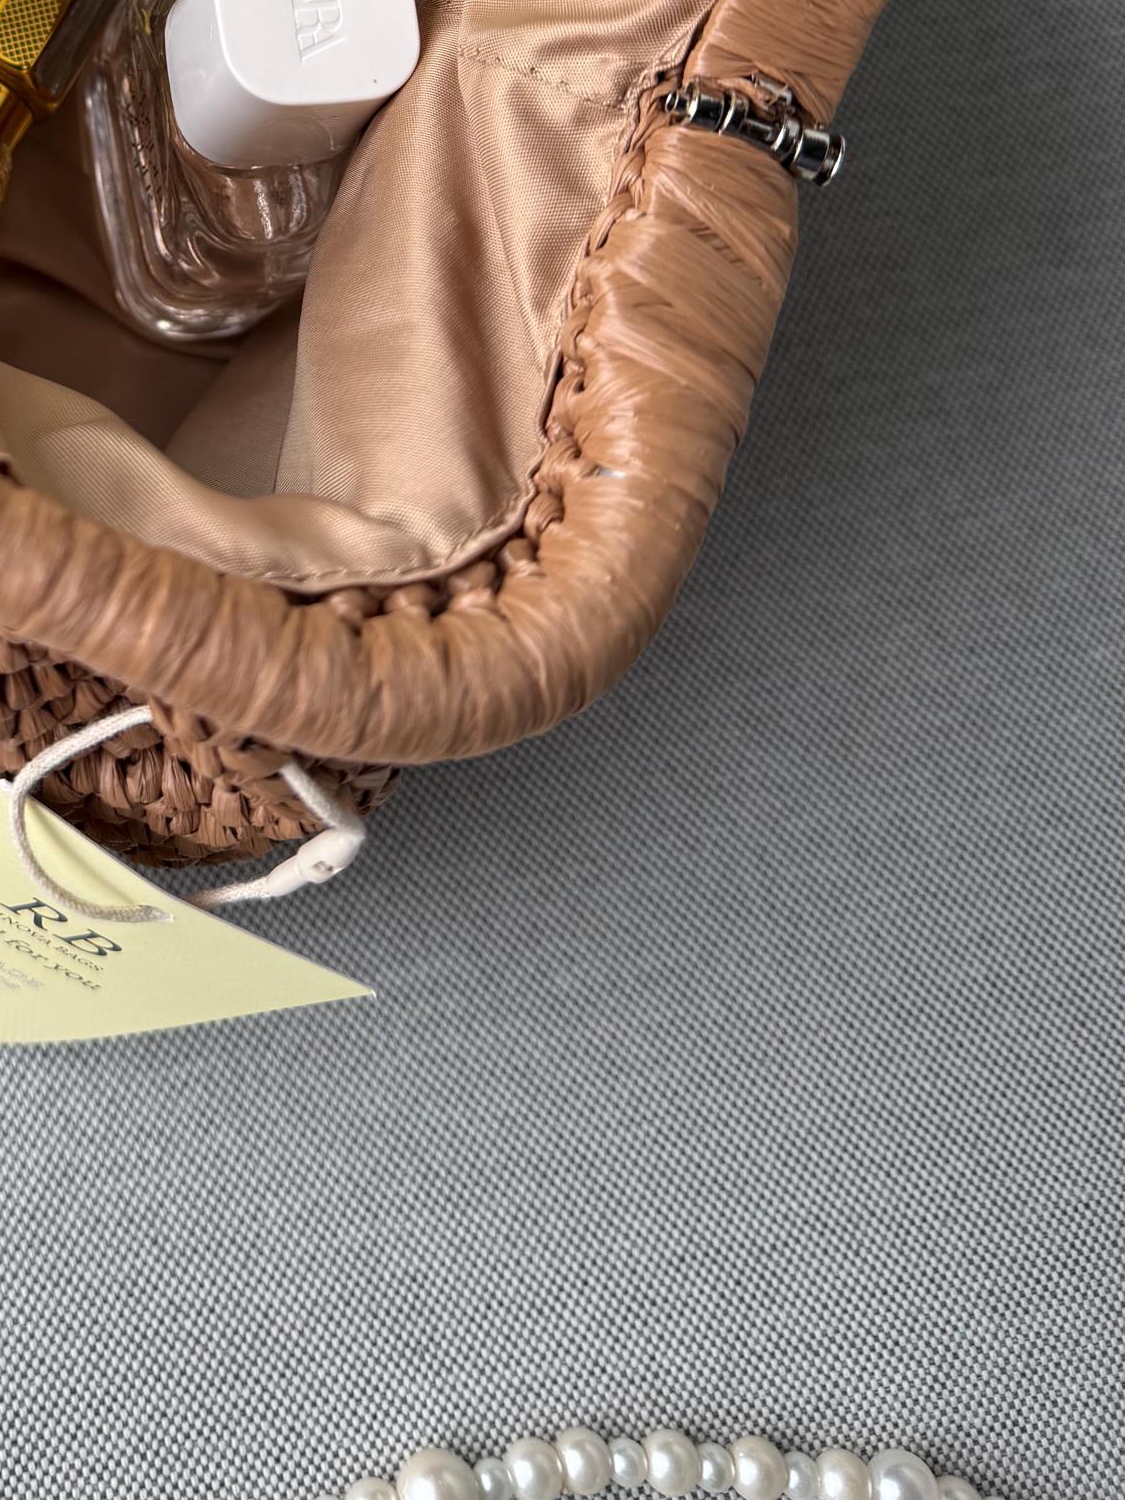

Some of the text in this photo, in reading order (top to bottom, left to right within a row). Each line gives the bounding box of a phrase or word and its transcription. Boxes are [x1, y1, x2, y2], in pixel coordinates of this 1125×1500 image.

[0, 897, 122, 956] RB
[5, 938, 50, 961] for
[43, 963, 103, 990] you
[55, 945, 104, 971] BAGS
